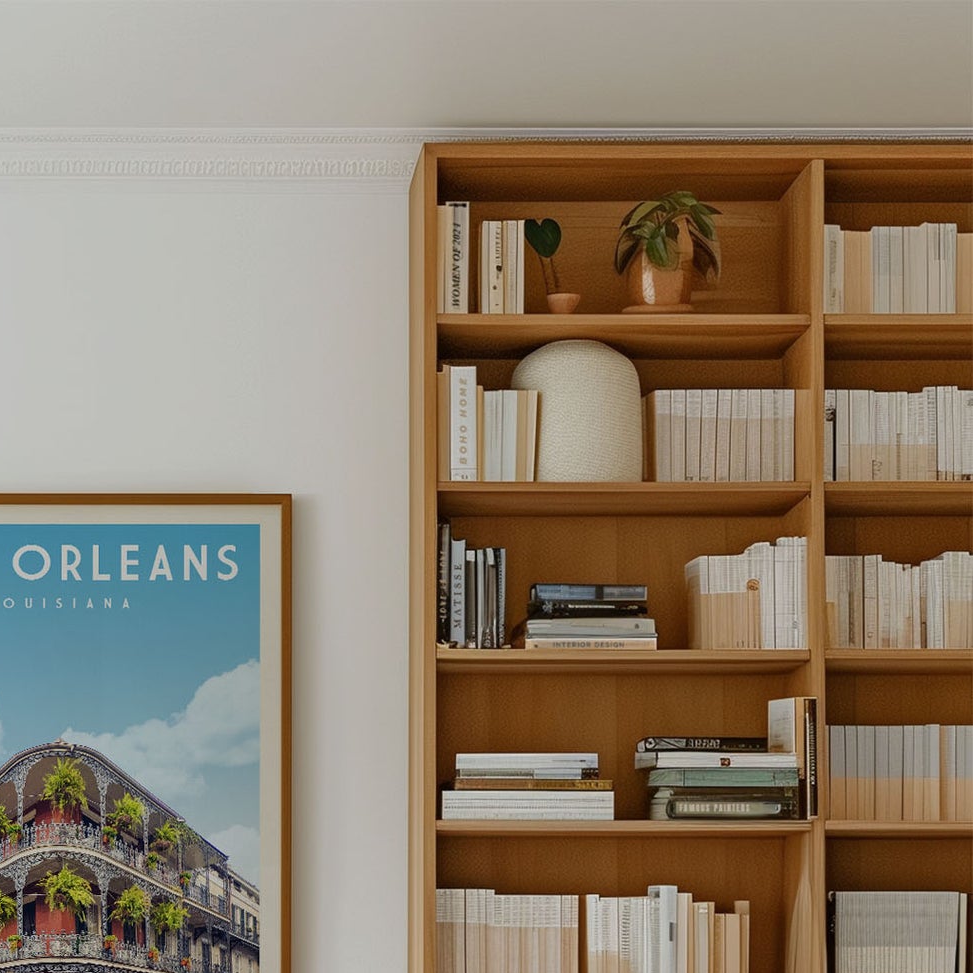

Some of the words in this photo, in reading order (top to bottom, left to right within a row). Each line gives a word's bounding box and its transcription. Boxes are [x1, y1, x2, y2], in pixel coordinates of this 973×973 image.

[452, 246, 461, 262] OF
[451, 264, 461, 307] WOMEN
[459, 378, 468, 418] HOME
[459, 425, 468, 465] BOHO
[12, 544, 239, 581] ORLEANS
[453, 563, 462, 629] MATISSE
[552, 641, 592, 649] INTERIOR
[594, 641, 625, 649] DESIGN
[679, 803, 710, 812] FAMOUS
[713, 803, 751, 812] PAINTERS
